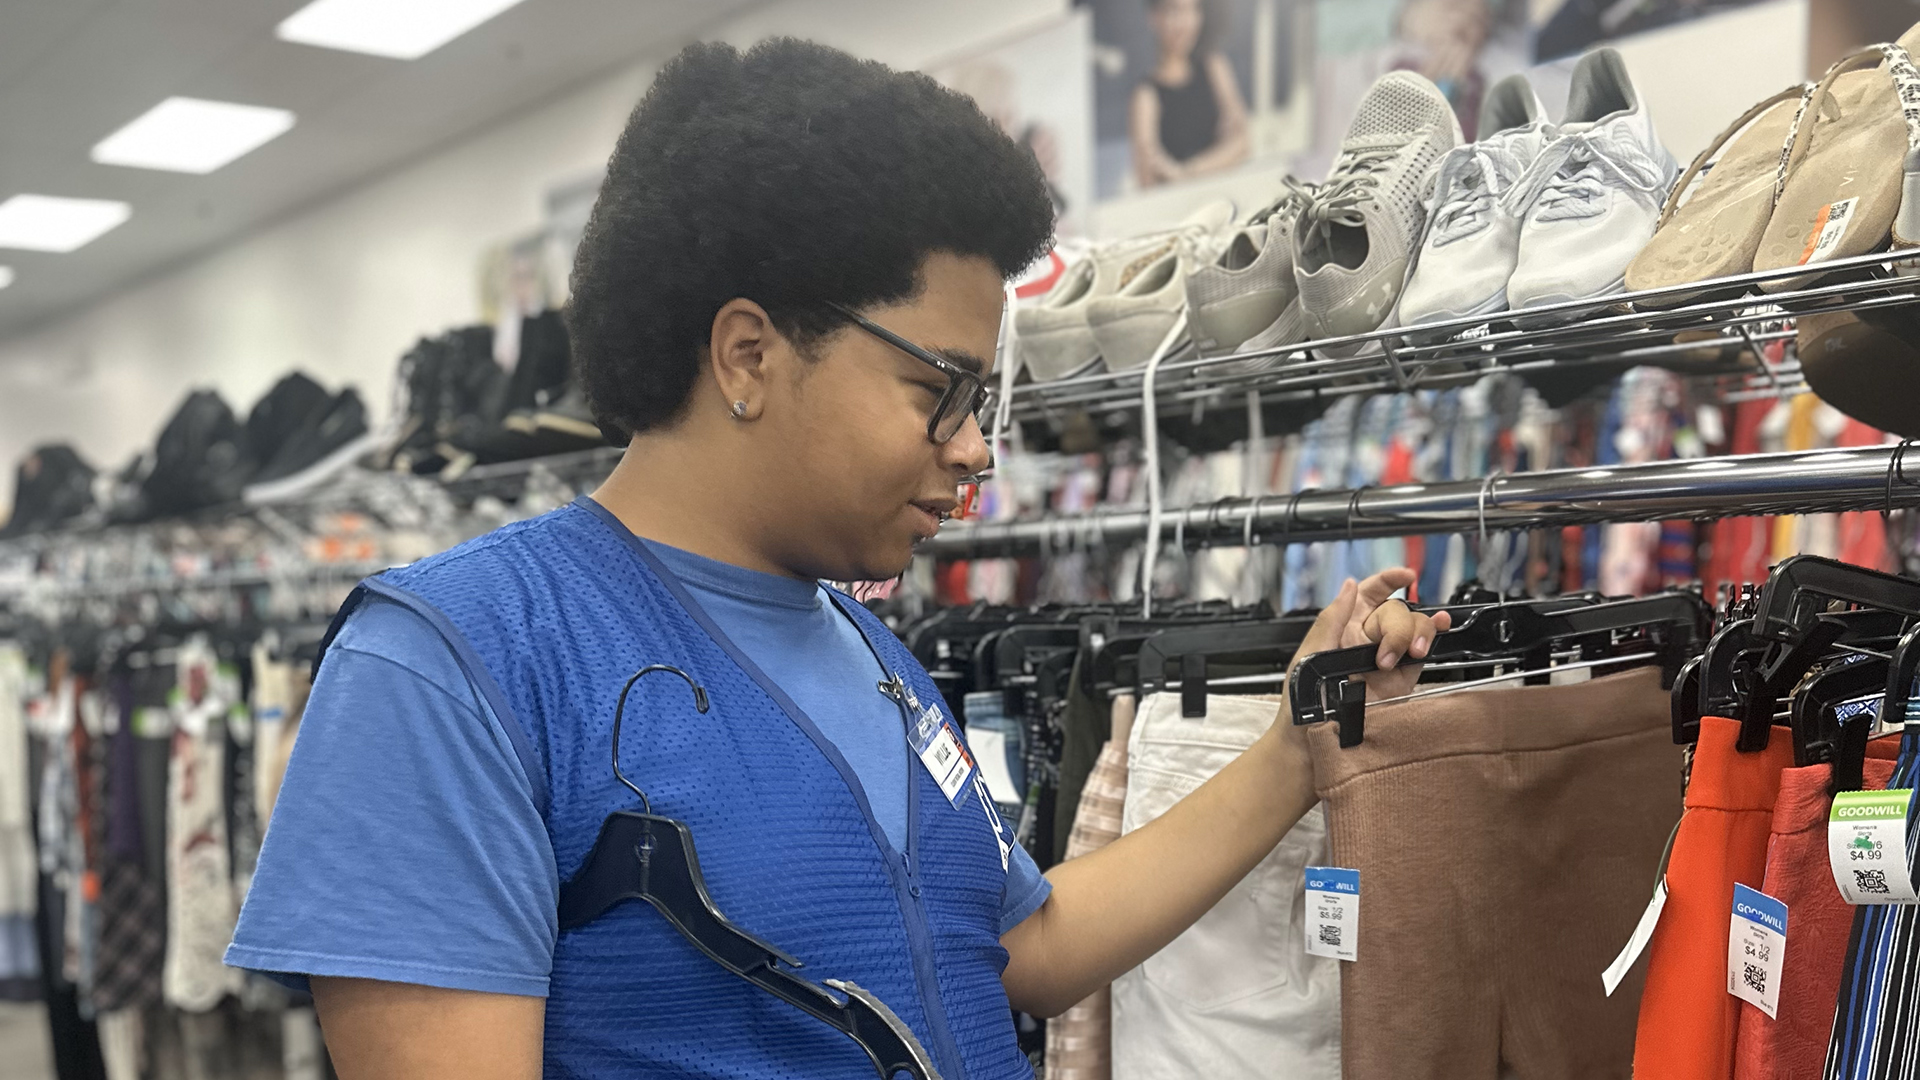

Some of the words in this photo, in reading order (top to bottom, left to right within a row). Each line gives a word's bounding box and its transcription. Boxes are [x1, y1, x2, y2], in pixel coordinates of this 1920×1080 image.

[1838, 805, 1901, 817] GOODWILL
[1850, 850, 1882, 861] $4.99
[1310, 880, 1354, 891] GOWILL
[1320, 911, 1342, 920] $5.99
[1745, 945, 1769, 962] $4.99
[1760, 943, 1771, 954] 1/2
